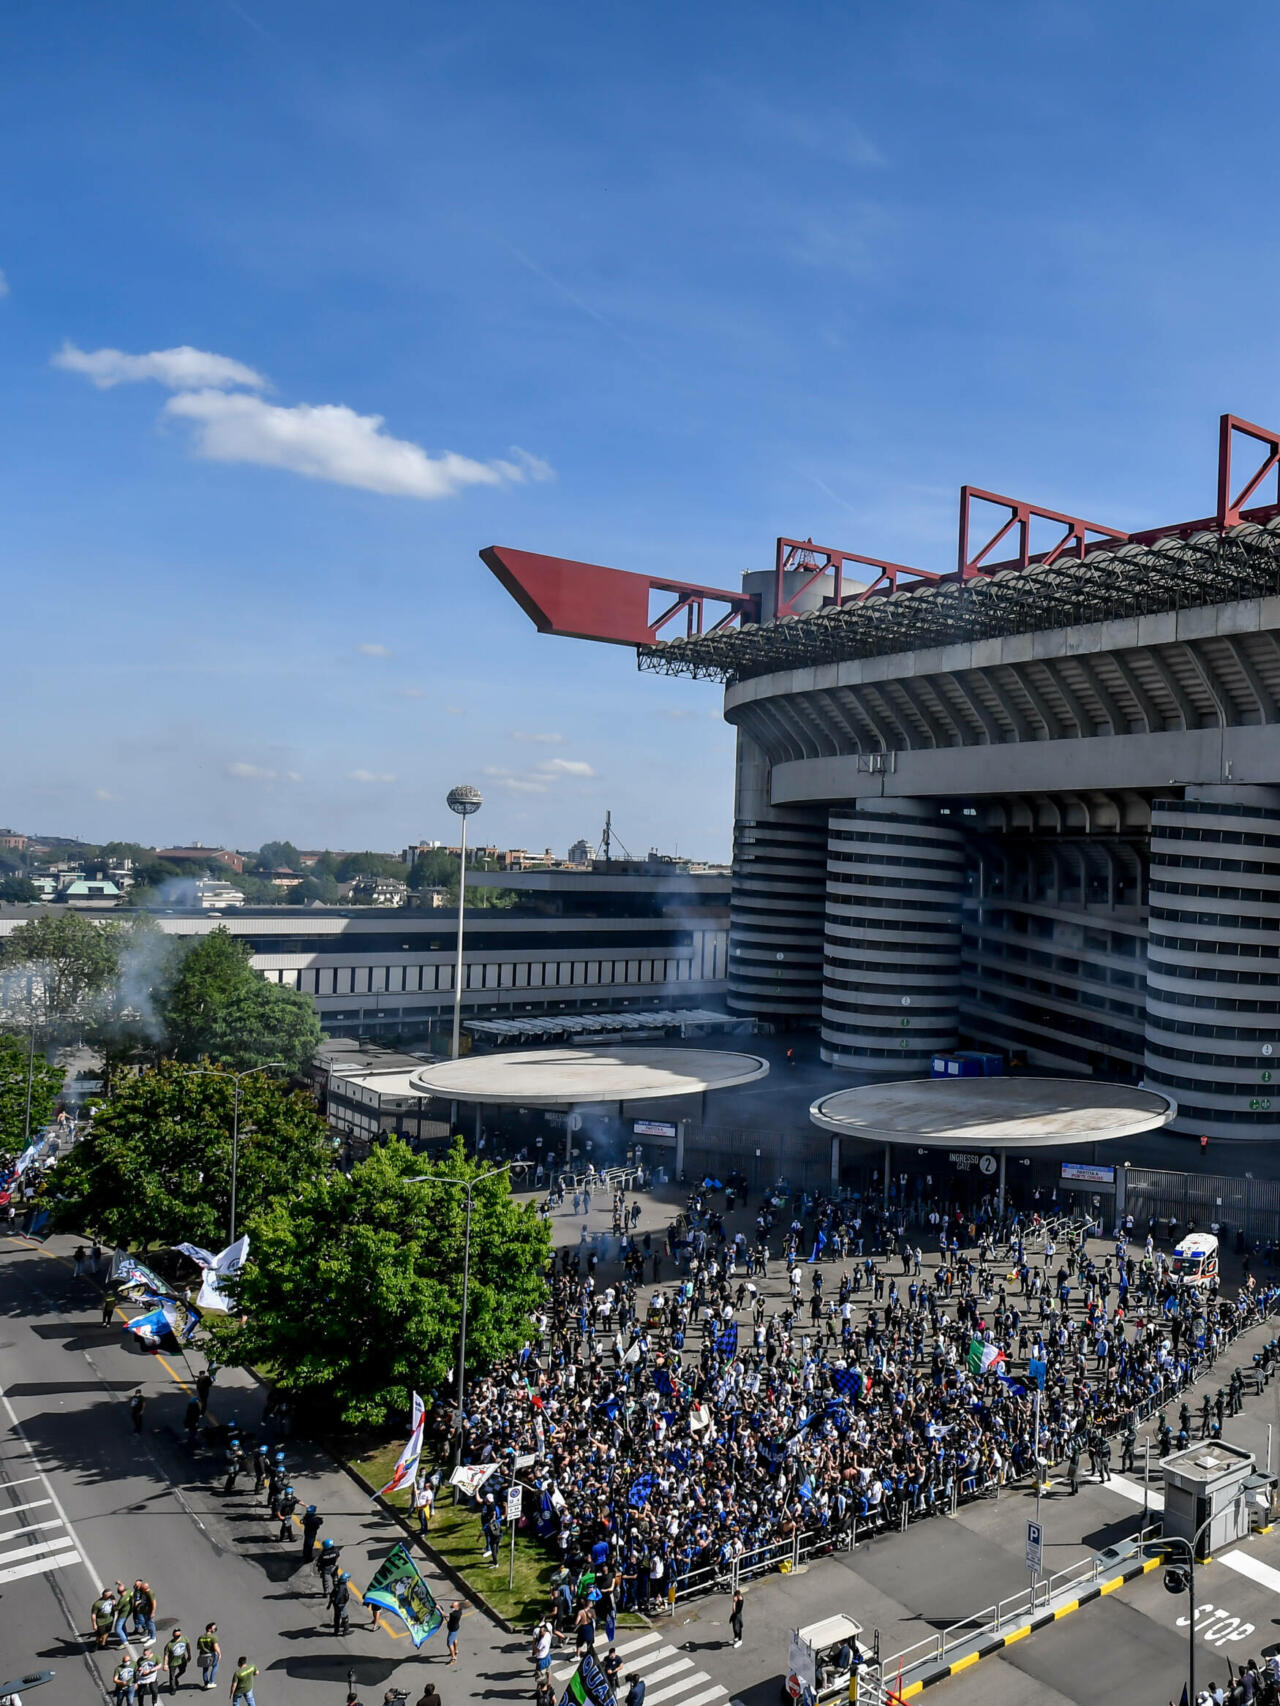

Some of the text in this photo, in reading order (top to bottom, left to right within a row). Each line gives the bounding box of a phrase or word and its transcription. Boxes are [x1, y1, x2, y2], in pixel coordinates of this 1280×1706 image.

[949, 1152, 979, 1164] INGRESSO
[1030, 1526, 1039, 1542] P
[1176, 1604, 1256, 1647] STOP
